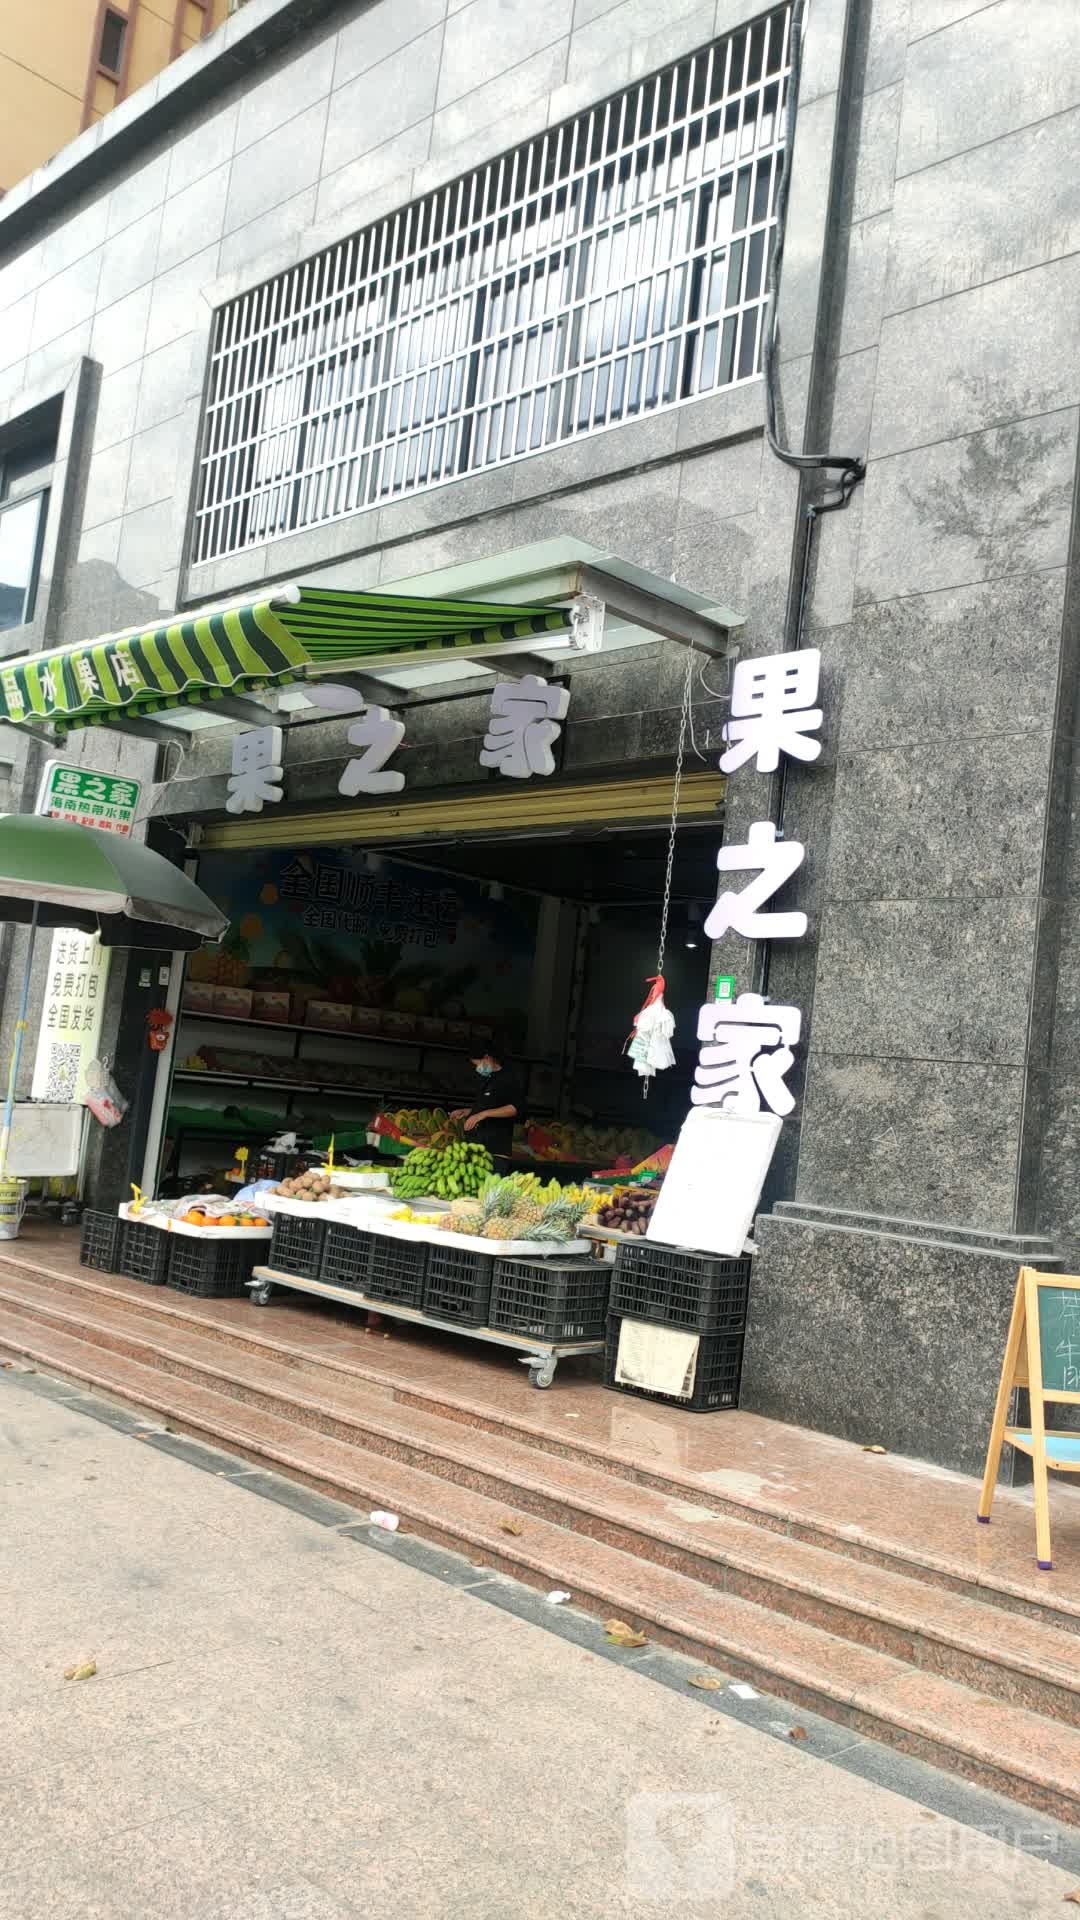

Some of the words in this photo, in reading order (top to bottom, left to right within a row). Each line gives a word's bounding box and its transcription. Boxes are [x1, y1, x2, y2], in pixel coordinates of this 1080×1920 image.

[3, 650, 141, 709] 品水果店
[225, 674, 571, 814] 果之家
[54, 770, 134, 806] 果之家
[50, 795, 131, 822] 海南热带水果
[690, 648, 825, 1117] 果之家
[50, 972, 99, 999] 免费打包
[47, 1003, 96, 1031] 全国发货
